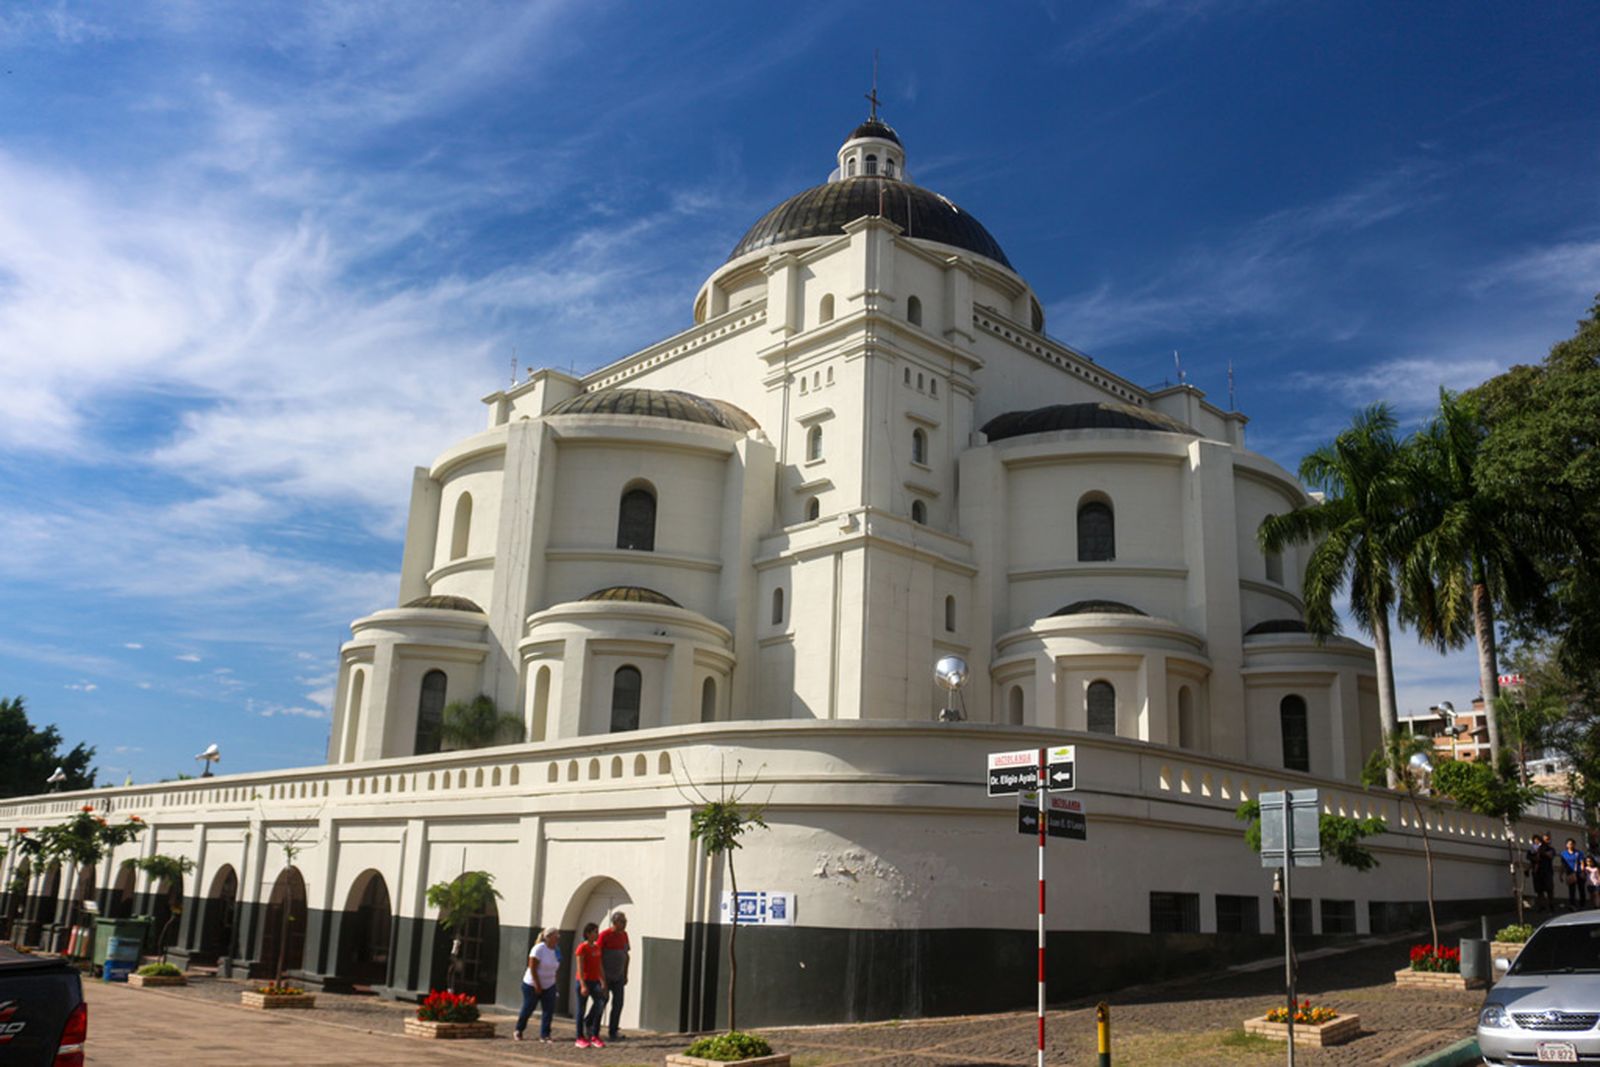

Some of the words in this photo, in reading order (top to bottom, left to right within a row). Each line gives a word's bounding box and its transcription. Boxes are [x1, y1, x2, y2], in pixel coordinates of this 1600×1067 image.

[990, 776, 1000, 785] Dr.
[1000, 774, 1018, 786] Eligio
[1019, 772, 1037, 785] Ayala
